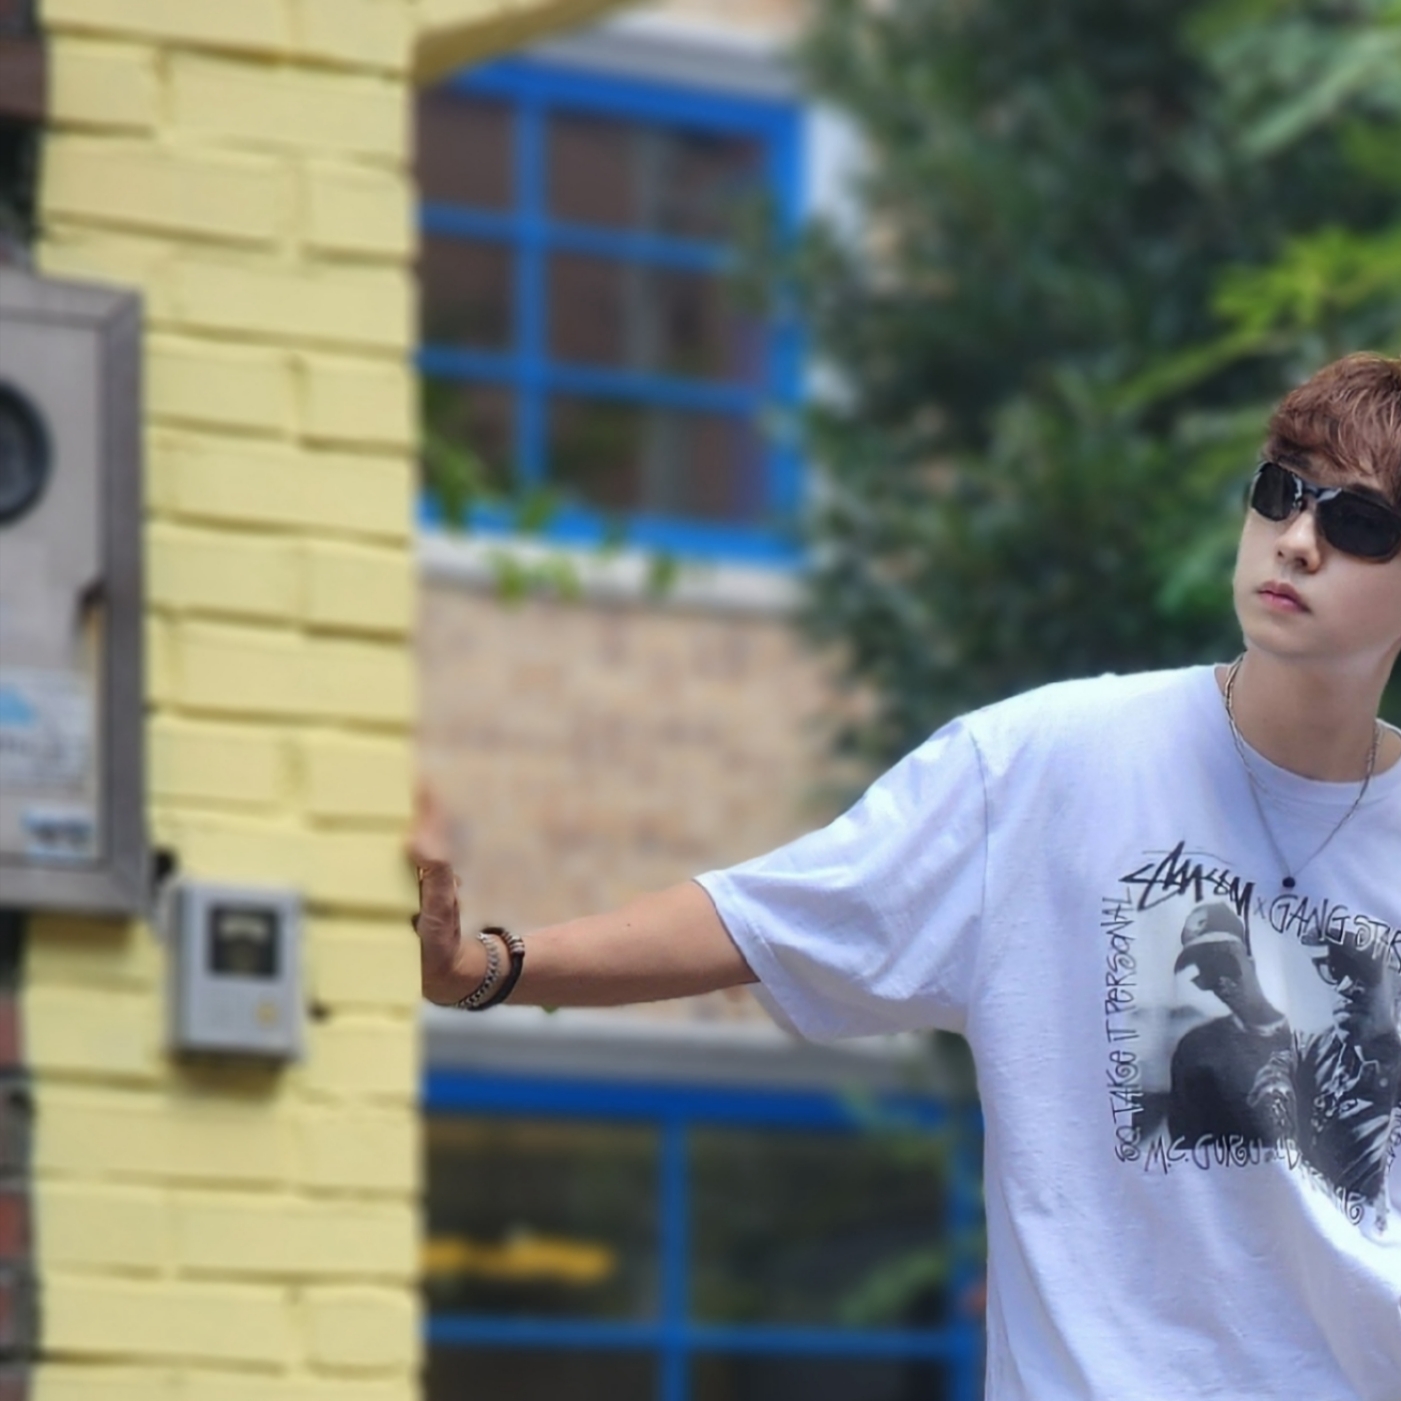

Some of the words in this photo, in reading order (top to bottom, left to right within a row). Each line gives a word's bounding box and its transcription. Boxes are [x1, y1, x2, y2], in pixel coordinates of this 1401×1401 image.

[1270, 894, 1350, 945] GANG
[1105, 1020, 1140, 1044] IT
[1192, 1134, 1262, 1171] GURU
